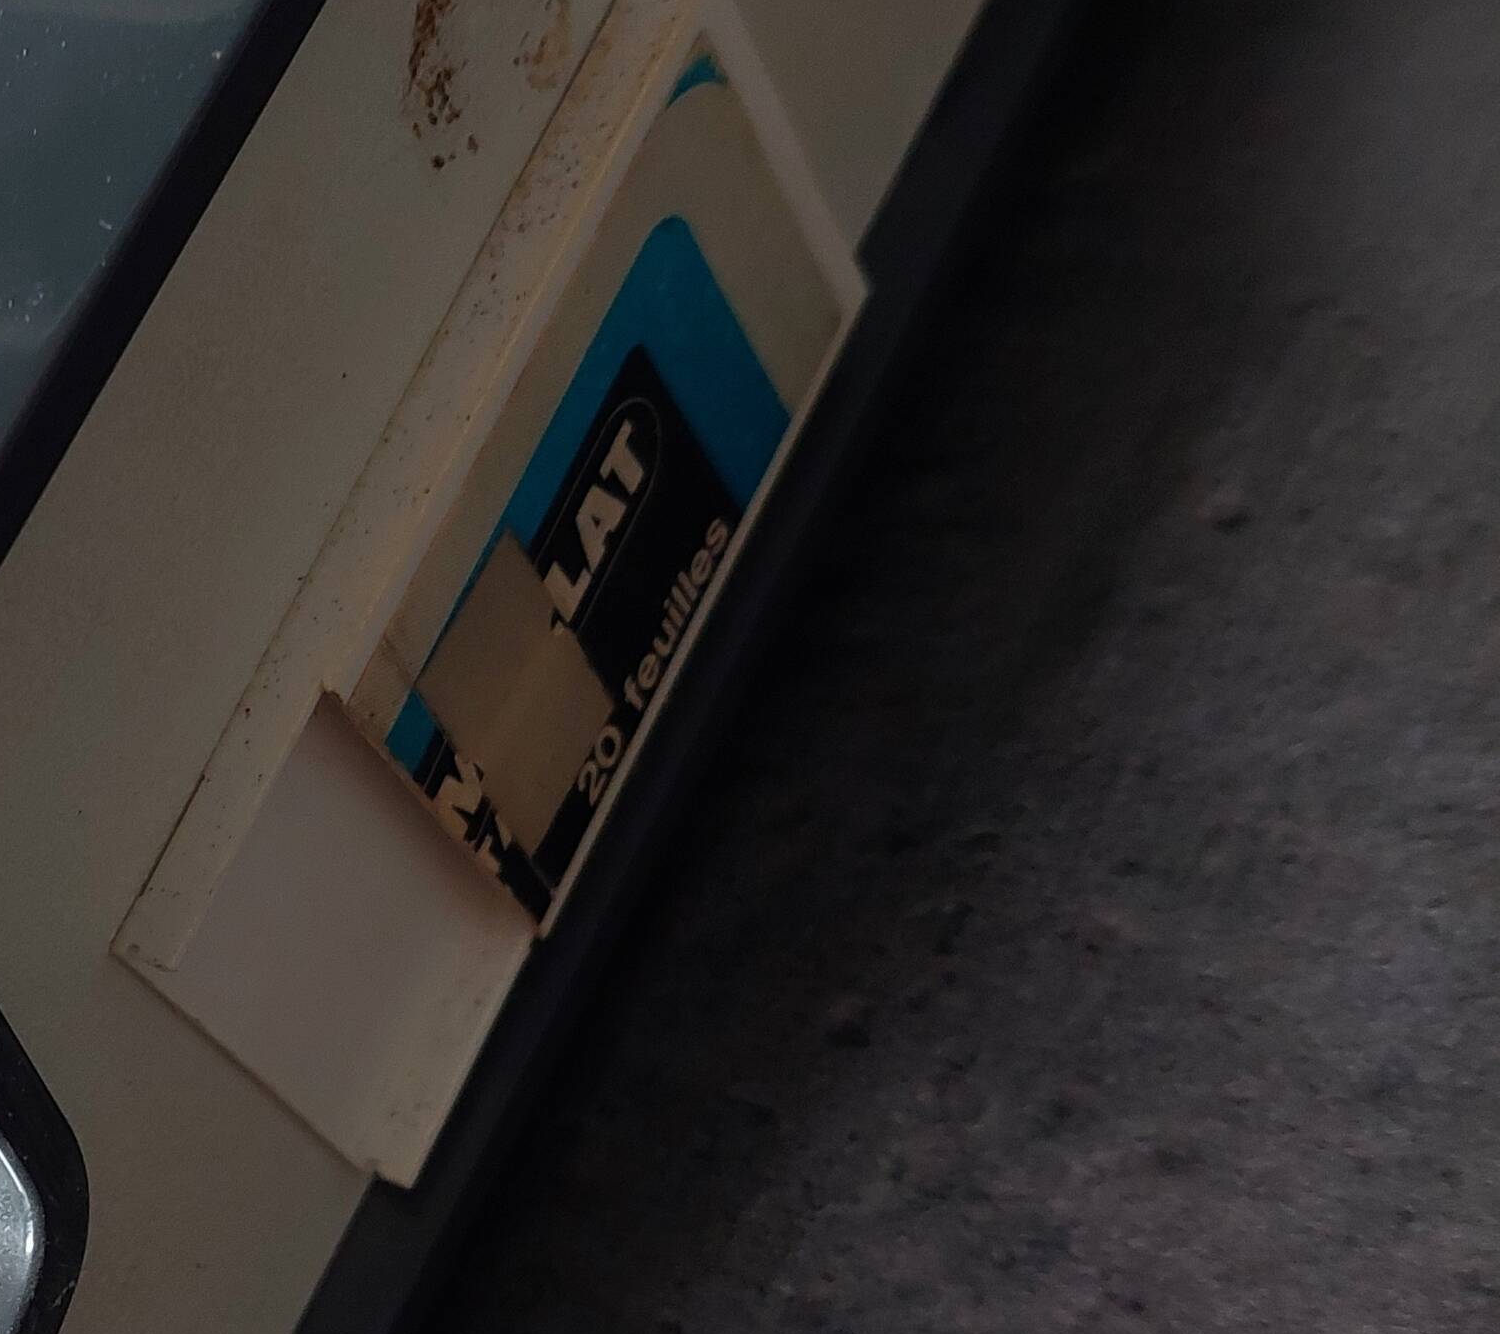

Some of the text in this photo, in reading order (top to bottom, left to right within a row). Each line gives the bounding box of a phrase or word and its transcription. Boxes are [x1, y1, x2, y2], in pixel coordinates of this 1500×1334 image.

[543, 418, 646, 631] LAT
[576, 516, 729, 807] 20 feuilles
